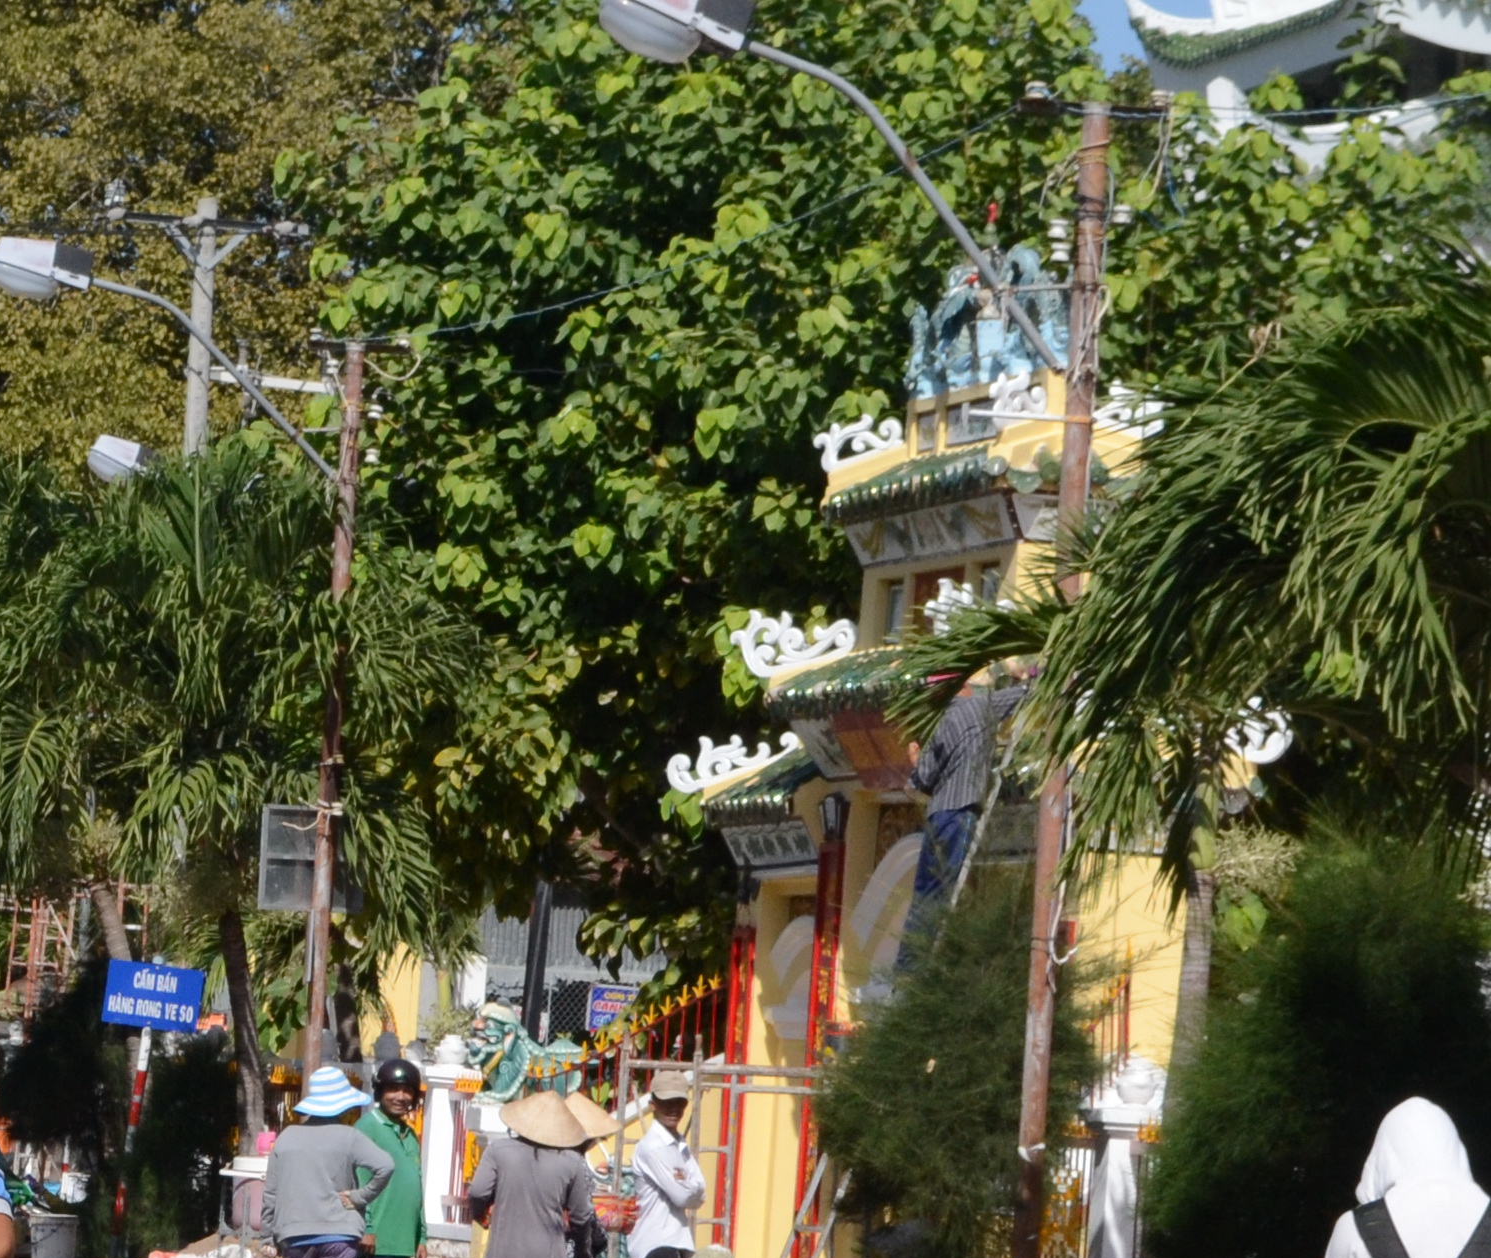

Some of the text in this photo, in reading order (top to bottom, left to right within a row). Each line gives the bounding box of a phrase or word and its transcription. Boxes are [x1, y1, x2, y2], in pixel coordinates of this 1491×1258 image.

[156, 972, 178, 993] BÁN
[107, 992, 135, 1015] HÀNG
[135, 998, 163, 1019] RONG
